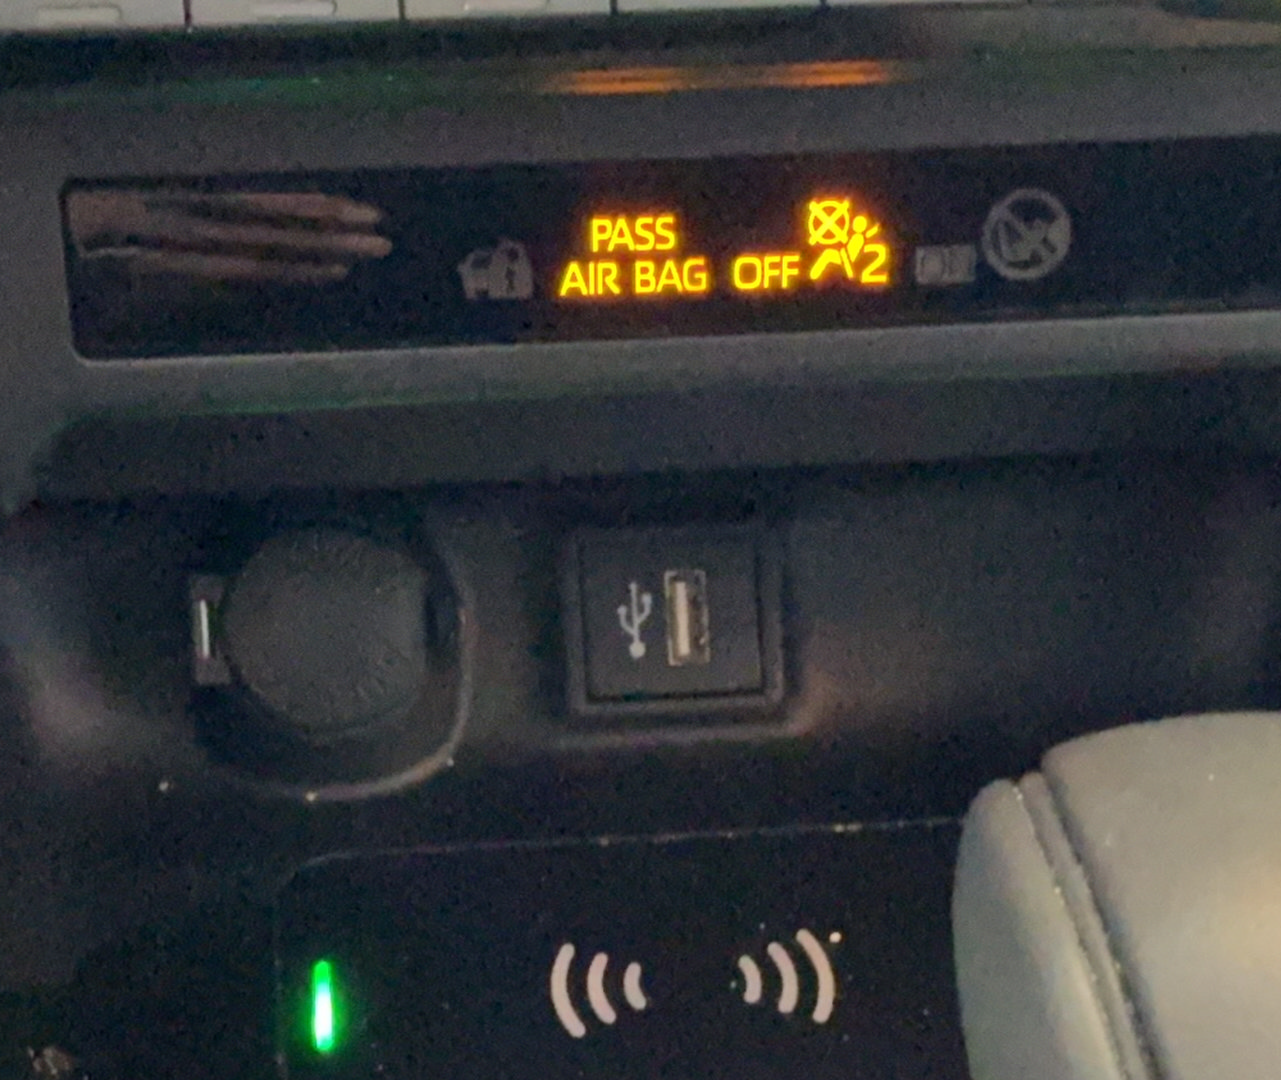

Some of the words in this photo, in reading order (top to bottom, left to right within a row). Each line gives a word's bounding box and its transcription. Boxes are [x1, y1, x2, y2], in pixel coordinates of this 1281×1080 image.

[590, 215, 676, 253] PASS
[559, 259, 620, 297] AIR
[634, 257, 708, 295] BAG
[732, 252, 801, 291] OFF
